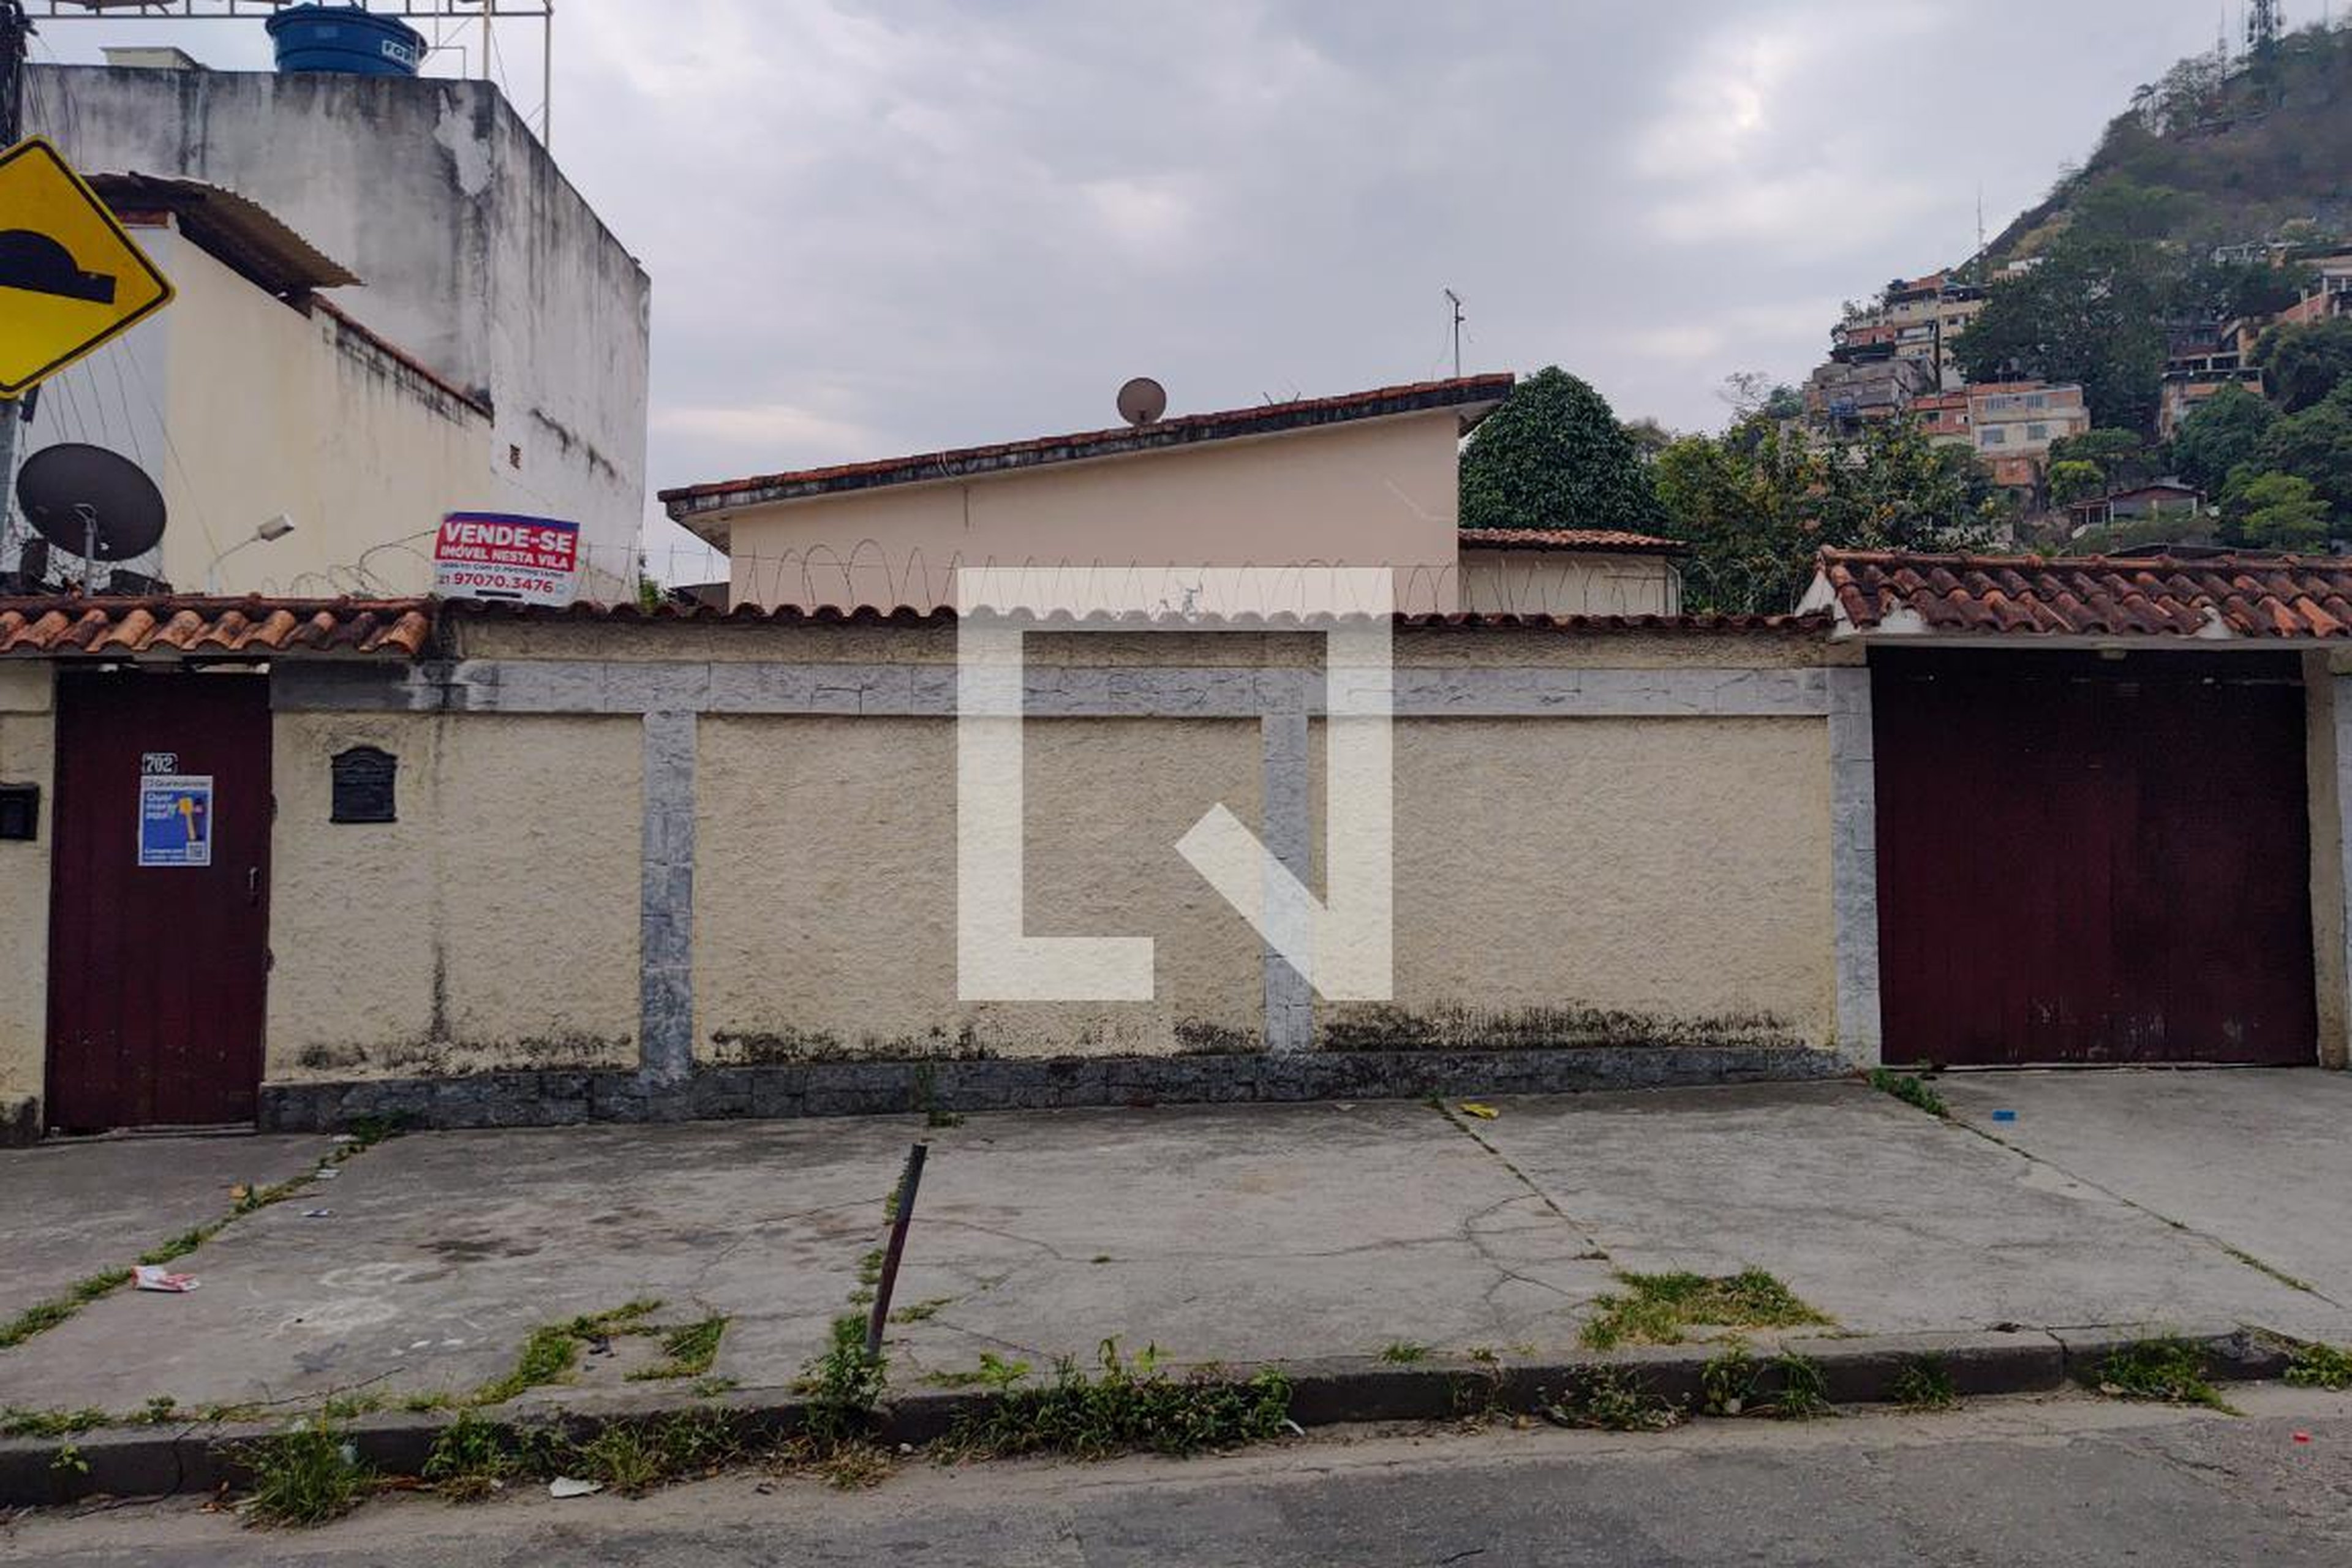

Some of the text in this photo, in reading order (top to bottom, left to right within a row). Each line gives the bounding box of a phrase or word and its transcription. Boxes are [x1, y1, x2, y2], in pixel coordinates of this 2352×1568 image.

[445, 522, 573, 554] VENDE-SE
[491, 549, 534, 565] NESTA
[538, 554, 569, 569] VILA
[454, 573, 554, 594] 97070.3476
[146, 756, 173, 773] 702
